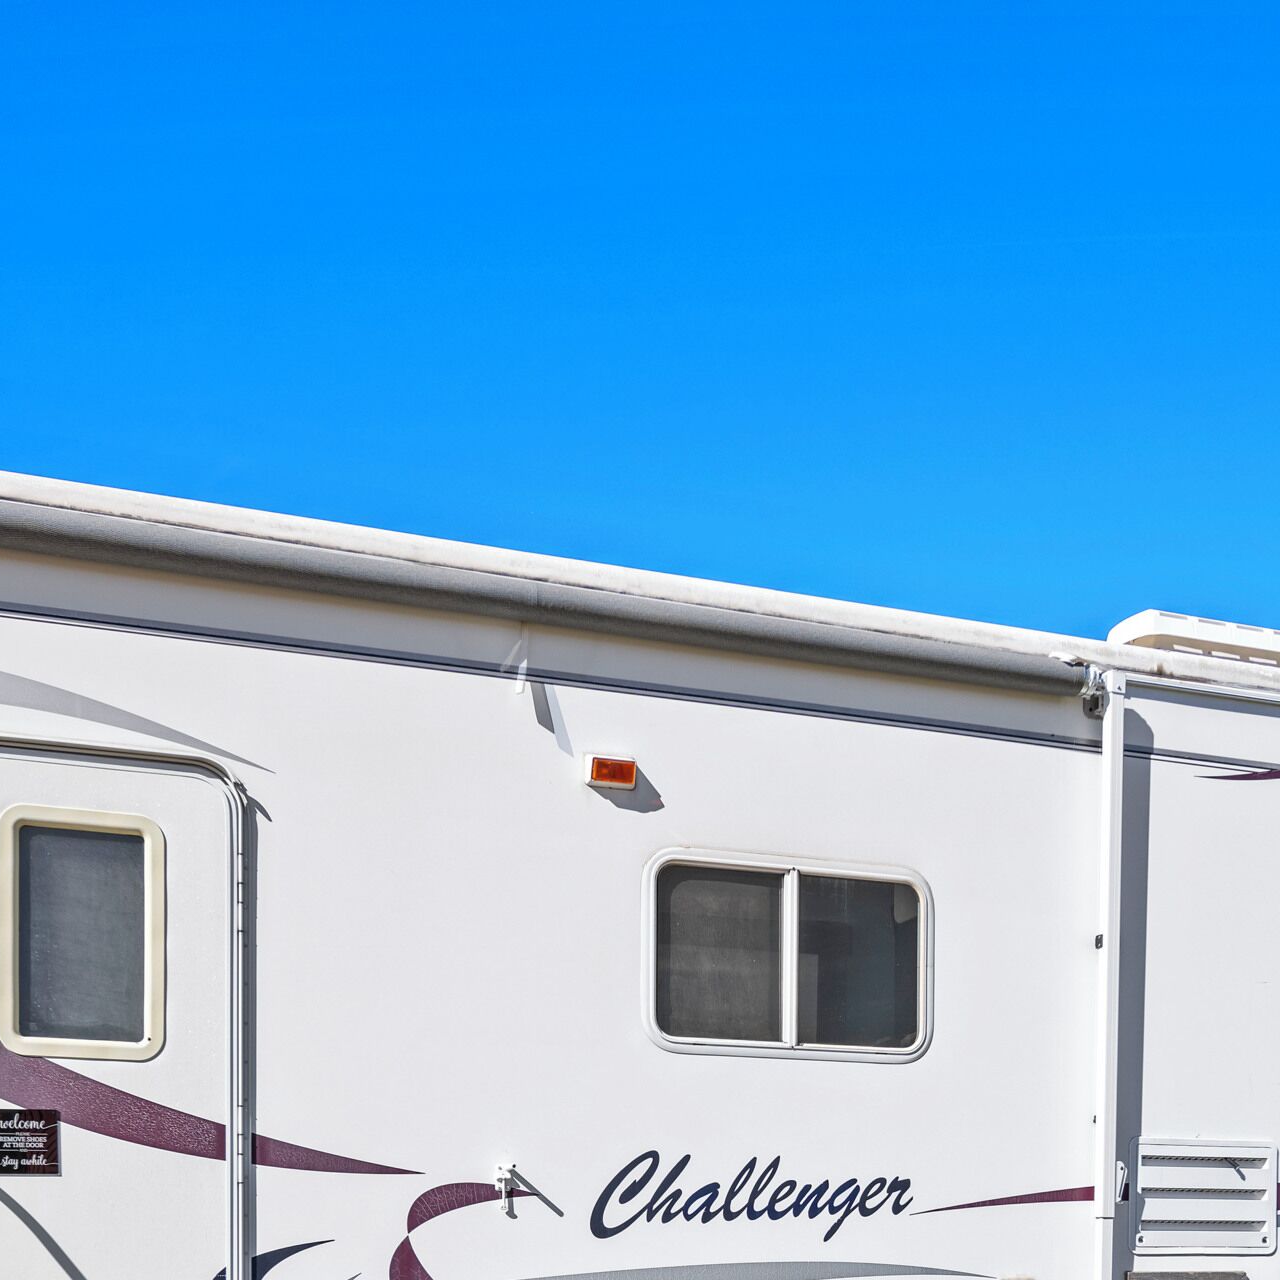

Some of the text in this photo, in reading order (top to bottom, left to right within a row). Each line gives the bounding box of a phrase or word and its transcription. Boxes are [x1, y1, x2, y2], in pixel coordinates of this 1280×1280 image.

[0, 1113, 46, 1130] welcome
[1, 1154, 47, 1170] stay awhile
[589, 1150, 914, 1242] Challenger
